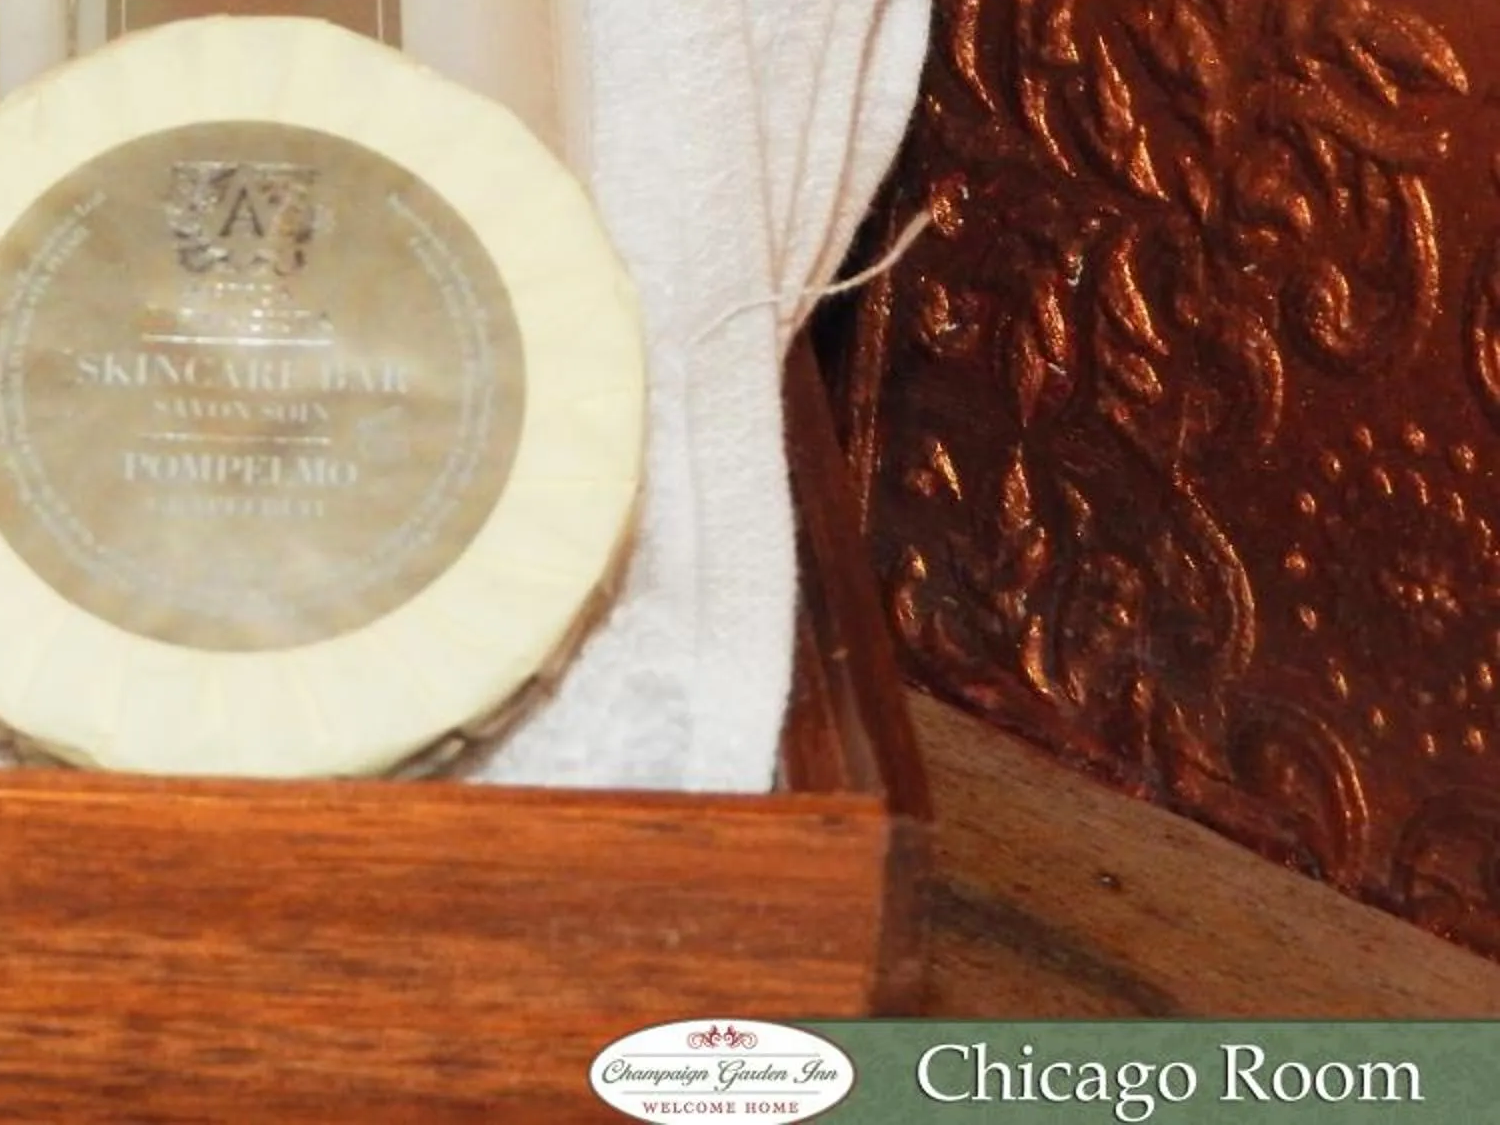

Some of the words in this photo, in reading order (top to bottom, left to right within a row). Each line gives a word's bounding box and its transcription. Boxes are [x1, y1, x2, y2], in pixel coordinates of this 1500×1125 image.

[75, 352, 296, 390] SKINCARE
[320, 361, 410, 395] BAR
[123, 452, 359, 486] POMPELMO
